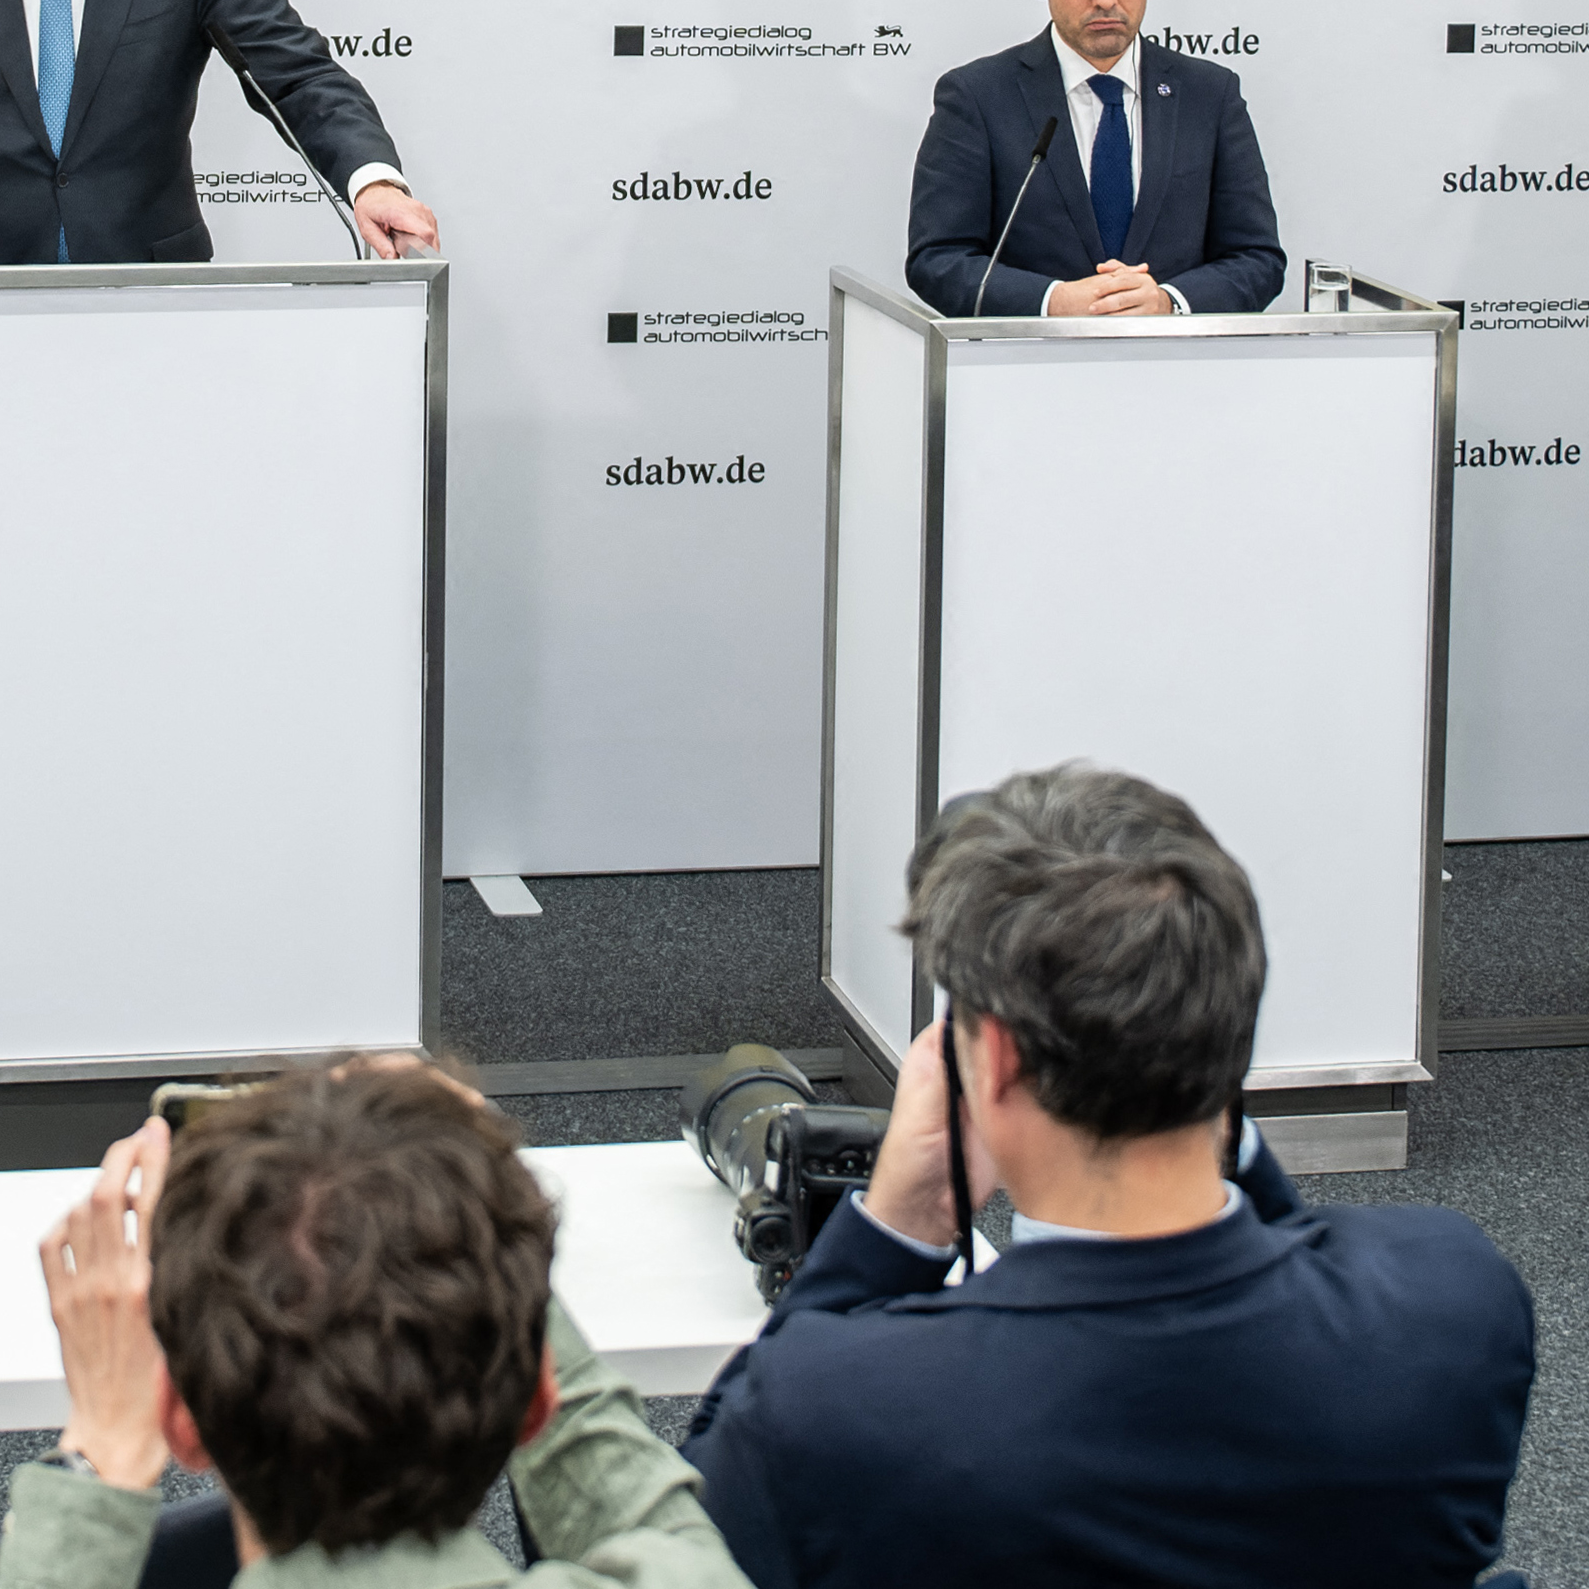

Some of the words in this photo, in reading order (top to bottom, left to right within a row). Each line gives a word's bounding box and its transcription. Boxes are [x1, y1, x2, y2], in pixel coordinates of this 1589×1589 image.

[650, 24, 812, 41] strategiedialog
[1146, 26, 1260, 56] bw.de
[322, 27, 413, 57] w.de
[650, 42, 866, 57] automobilwirtschaft
[873, 42, 912, 57] BW
[194, 170, 307, 187] egiedialog
[611, 170, 773, 201] sdabw.de
[197, 189, 343, 204] mobilwirtsch
[643, 310, 805, 327] strategiedialog
[643, 328, 829, 344] automobilwirtsch
[1455, 437, 1581, 468] dabw.de
[605, 454, 766, 487] sdabw.de
